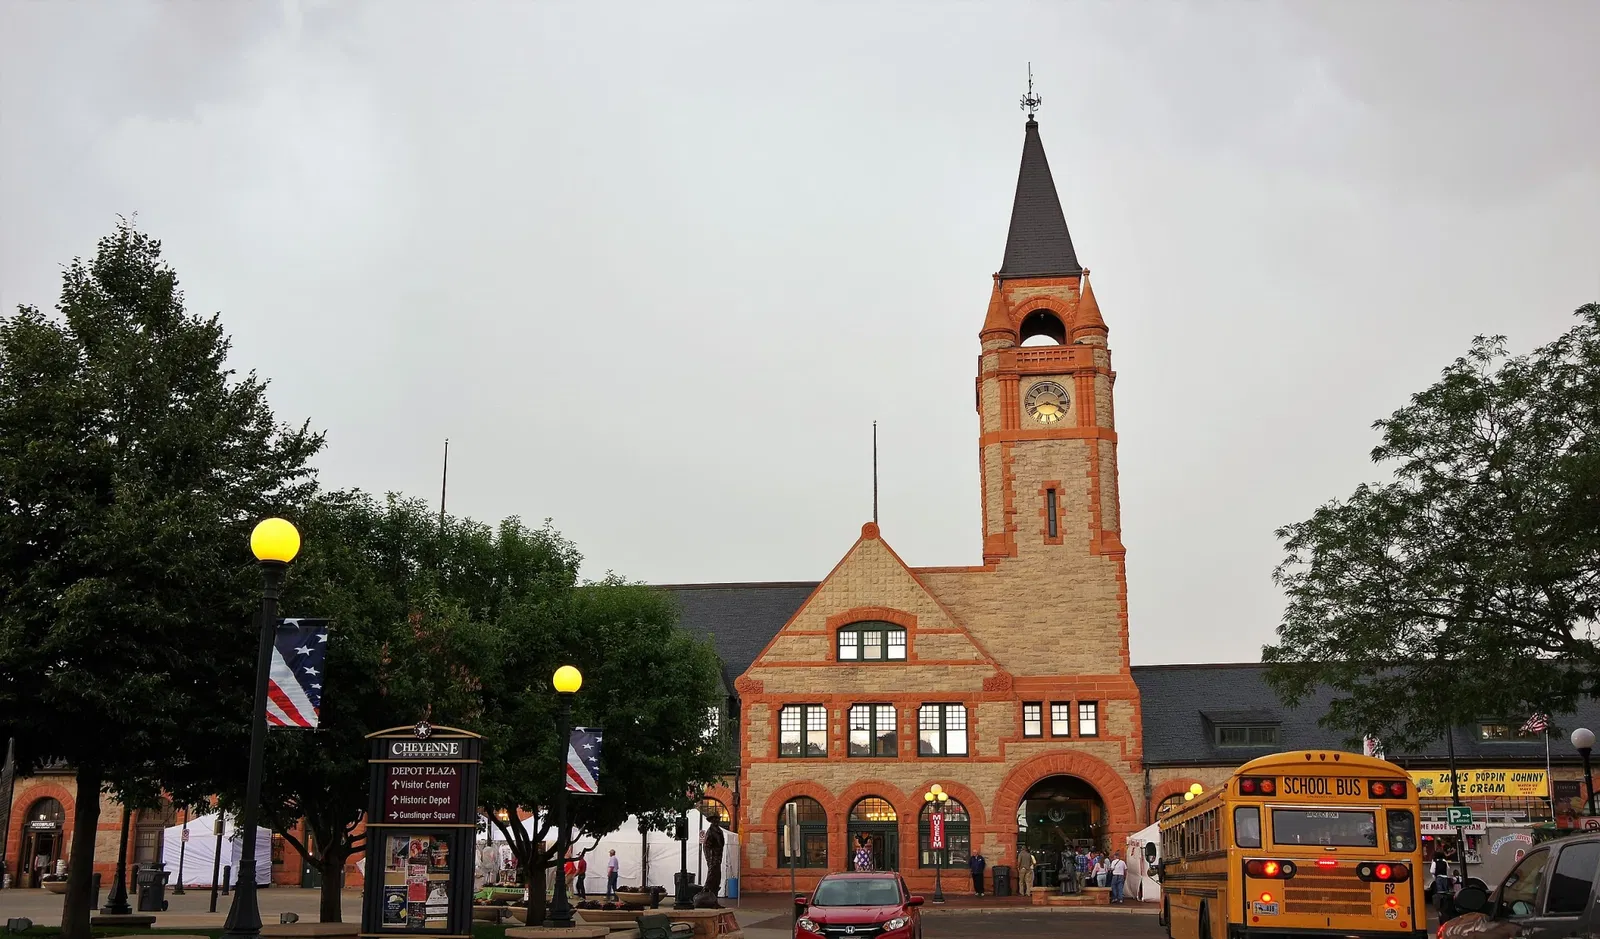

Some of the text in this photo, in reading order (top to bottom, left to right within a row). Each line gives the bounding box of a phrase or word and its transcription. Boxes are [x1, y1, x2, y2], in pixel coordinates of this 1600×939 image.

[391, 742, 459, 755] CHEYENNE
[392, 767, 456, 775] DEPOT PLAZA
[1439, 773, 1469, 783] ZAH'S
[1510, 772, 1544, 783] JOHNNY
[400, 780, 450, 789] Visitor Center
[1284, 777, 1361, 796] SCHOOL BUS
[1469, 783, 1506, 794] CREAM
[400, 795, 451, 807] Historic Depot
[399, 811, 456, 821] Gunslinger Square
[1449, 809, 1462, 823] P
[932, 814, 941, 848] MUSEUM
[1384, 883, 1395, 895] 62
